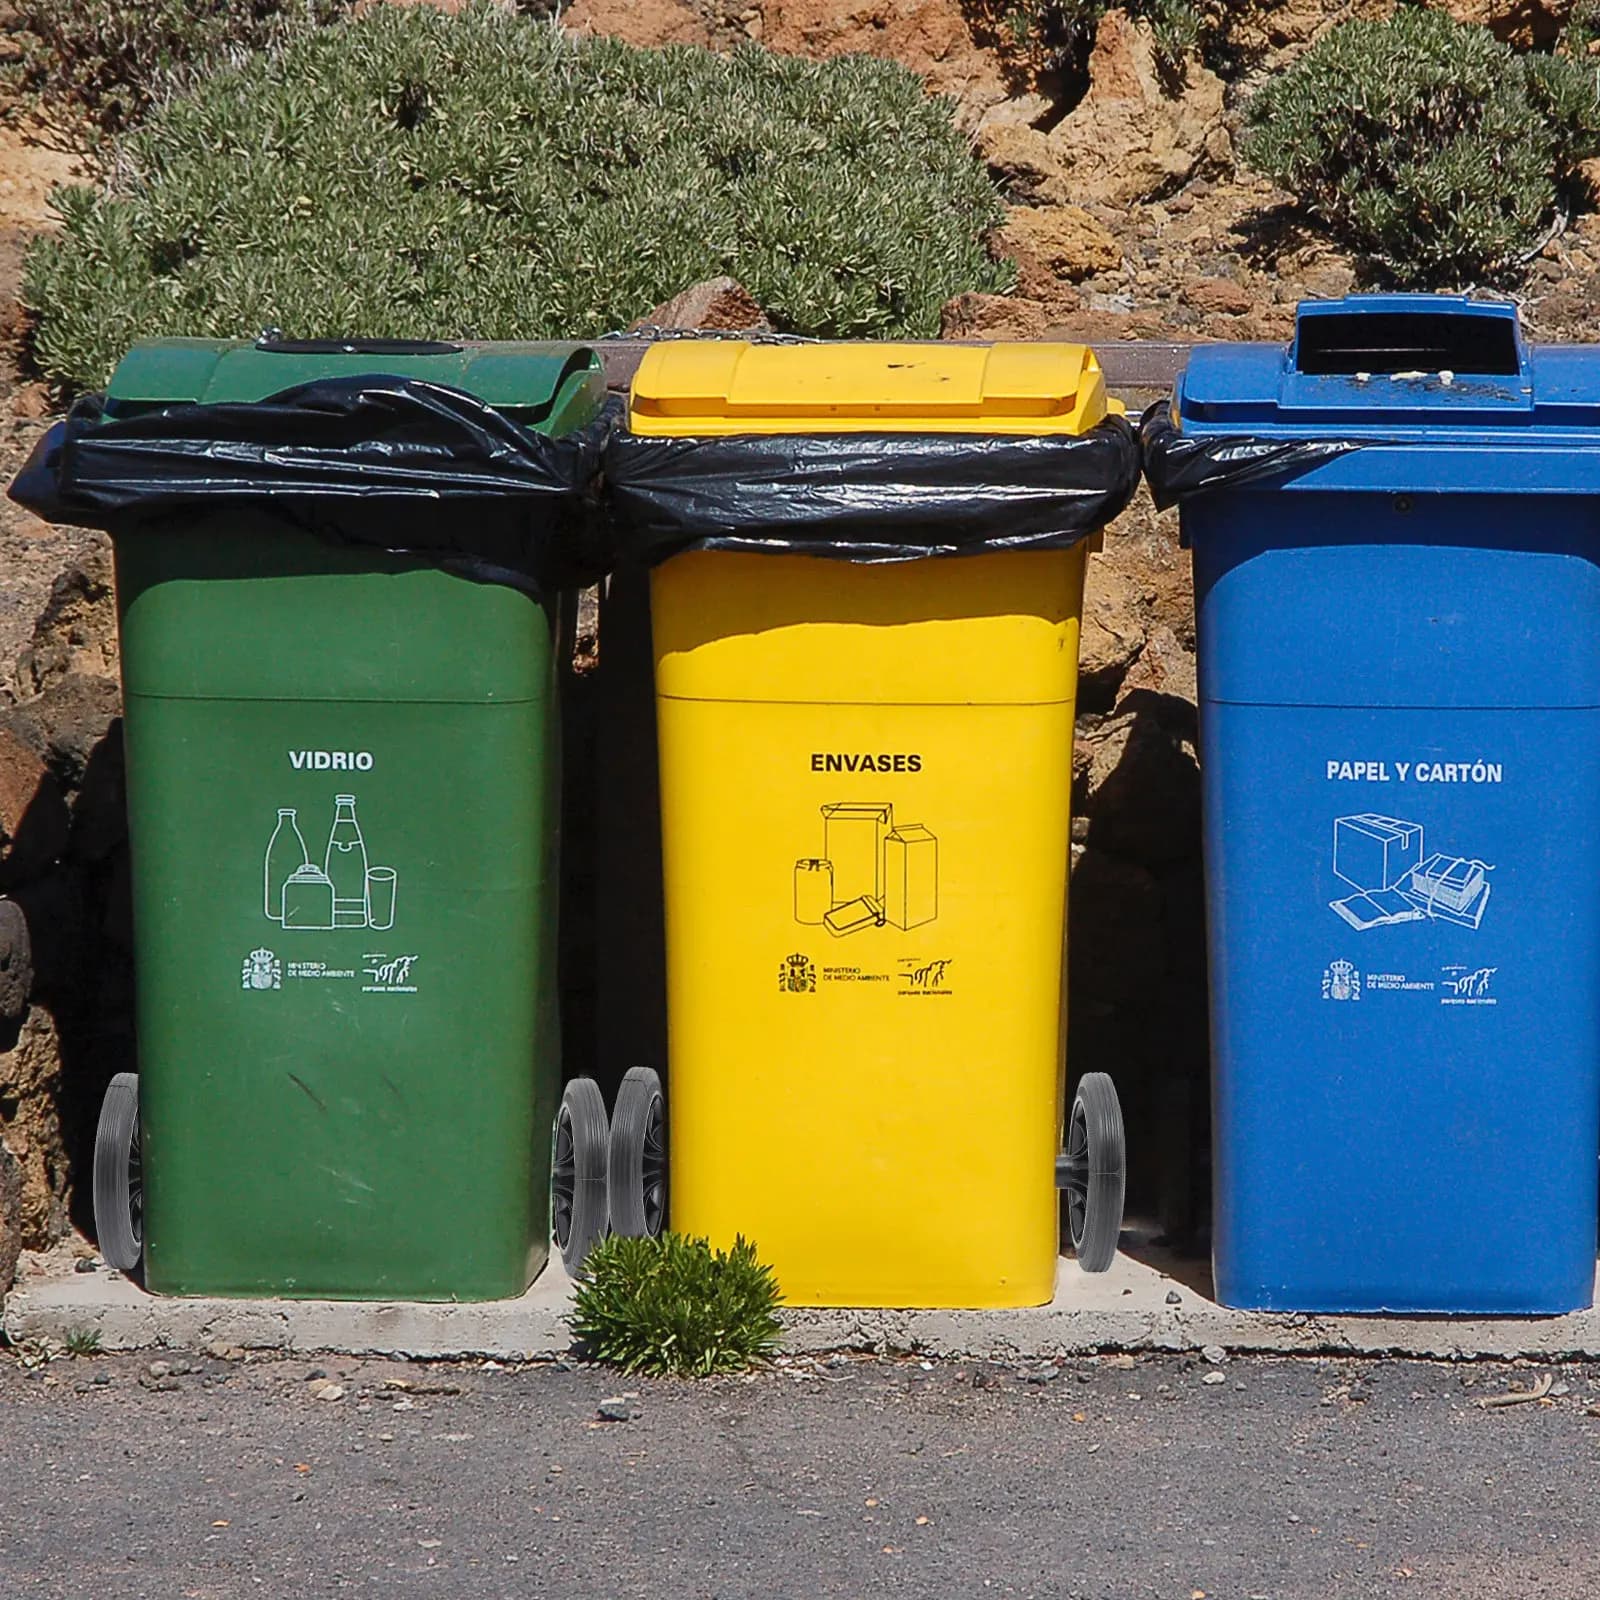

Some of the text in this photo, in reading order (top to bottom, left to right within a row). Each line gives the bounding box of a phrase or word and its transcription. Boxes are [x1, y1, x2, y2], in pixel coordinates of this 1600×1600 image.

[289, 751, 374, 770] VIDRIO
[811, 754, 922, 773] ENVASES
[1326, 758, 1503, 783] PAPEL Y CARTÓN
